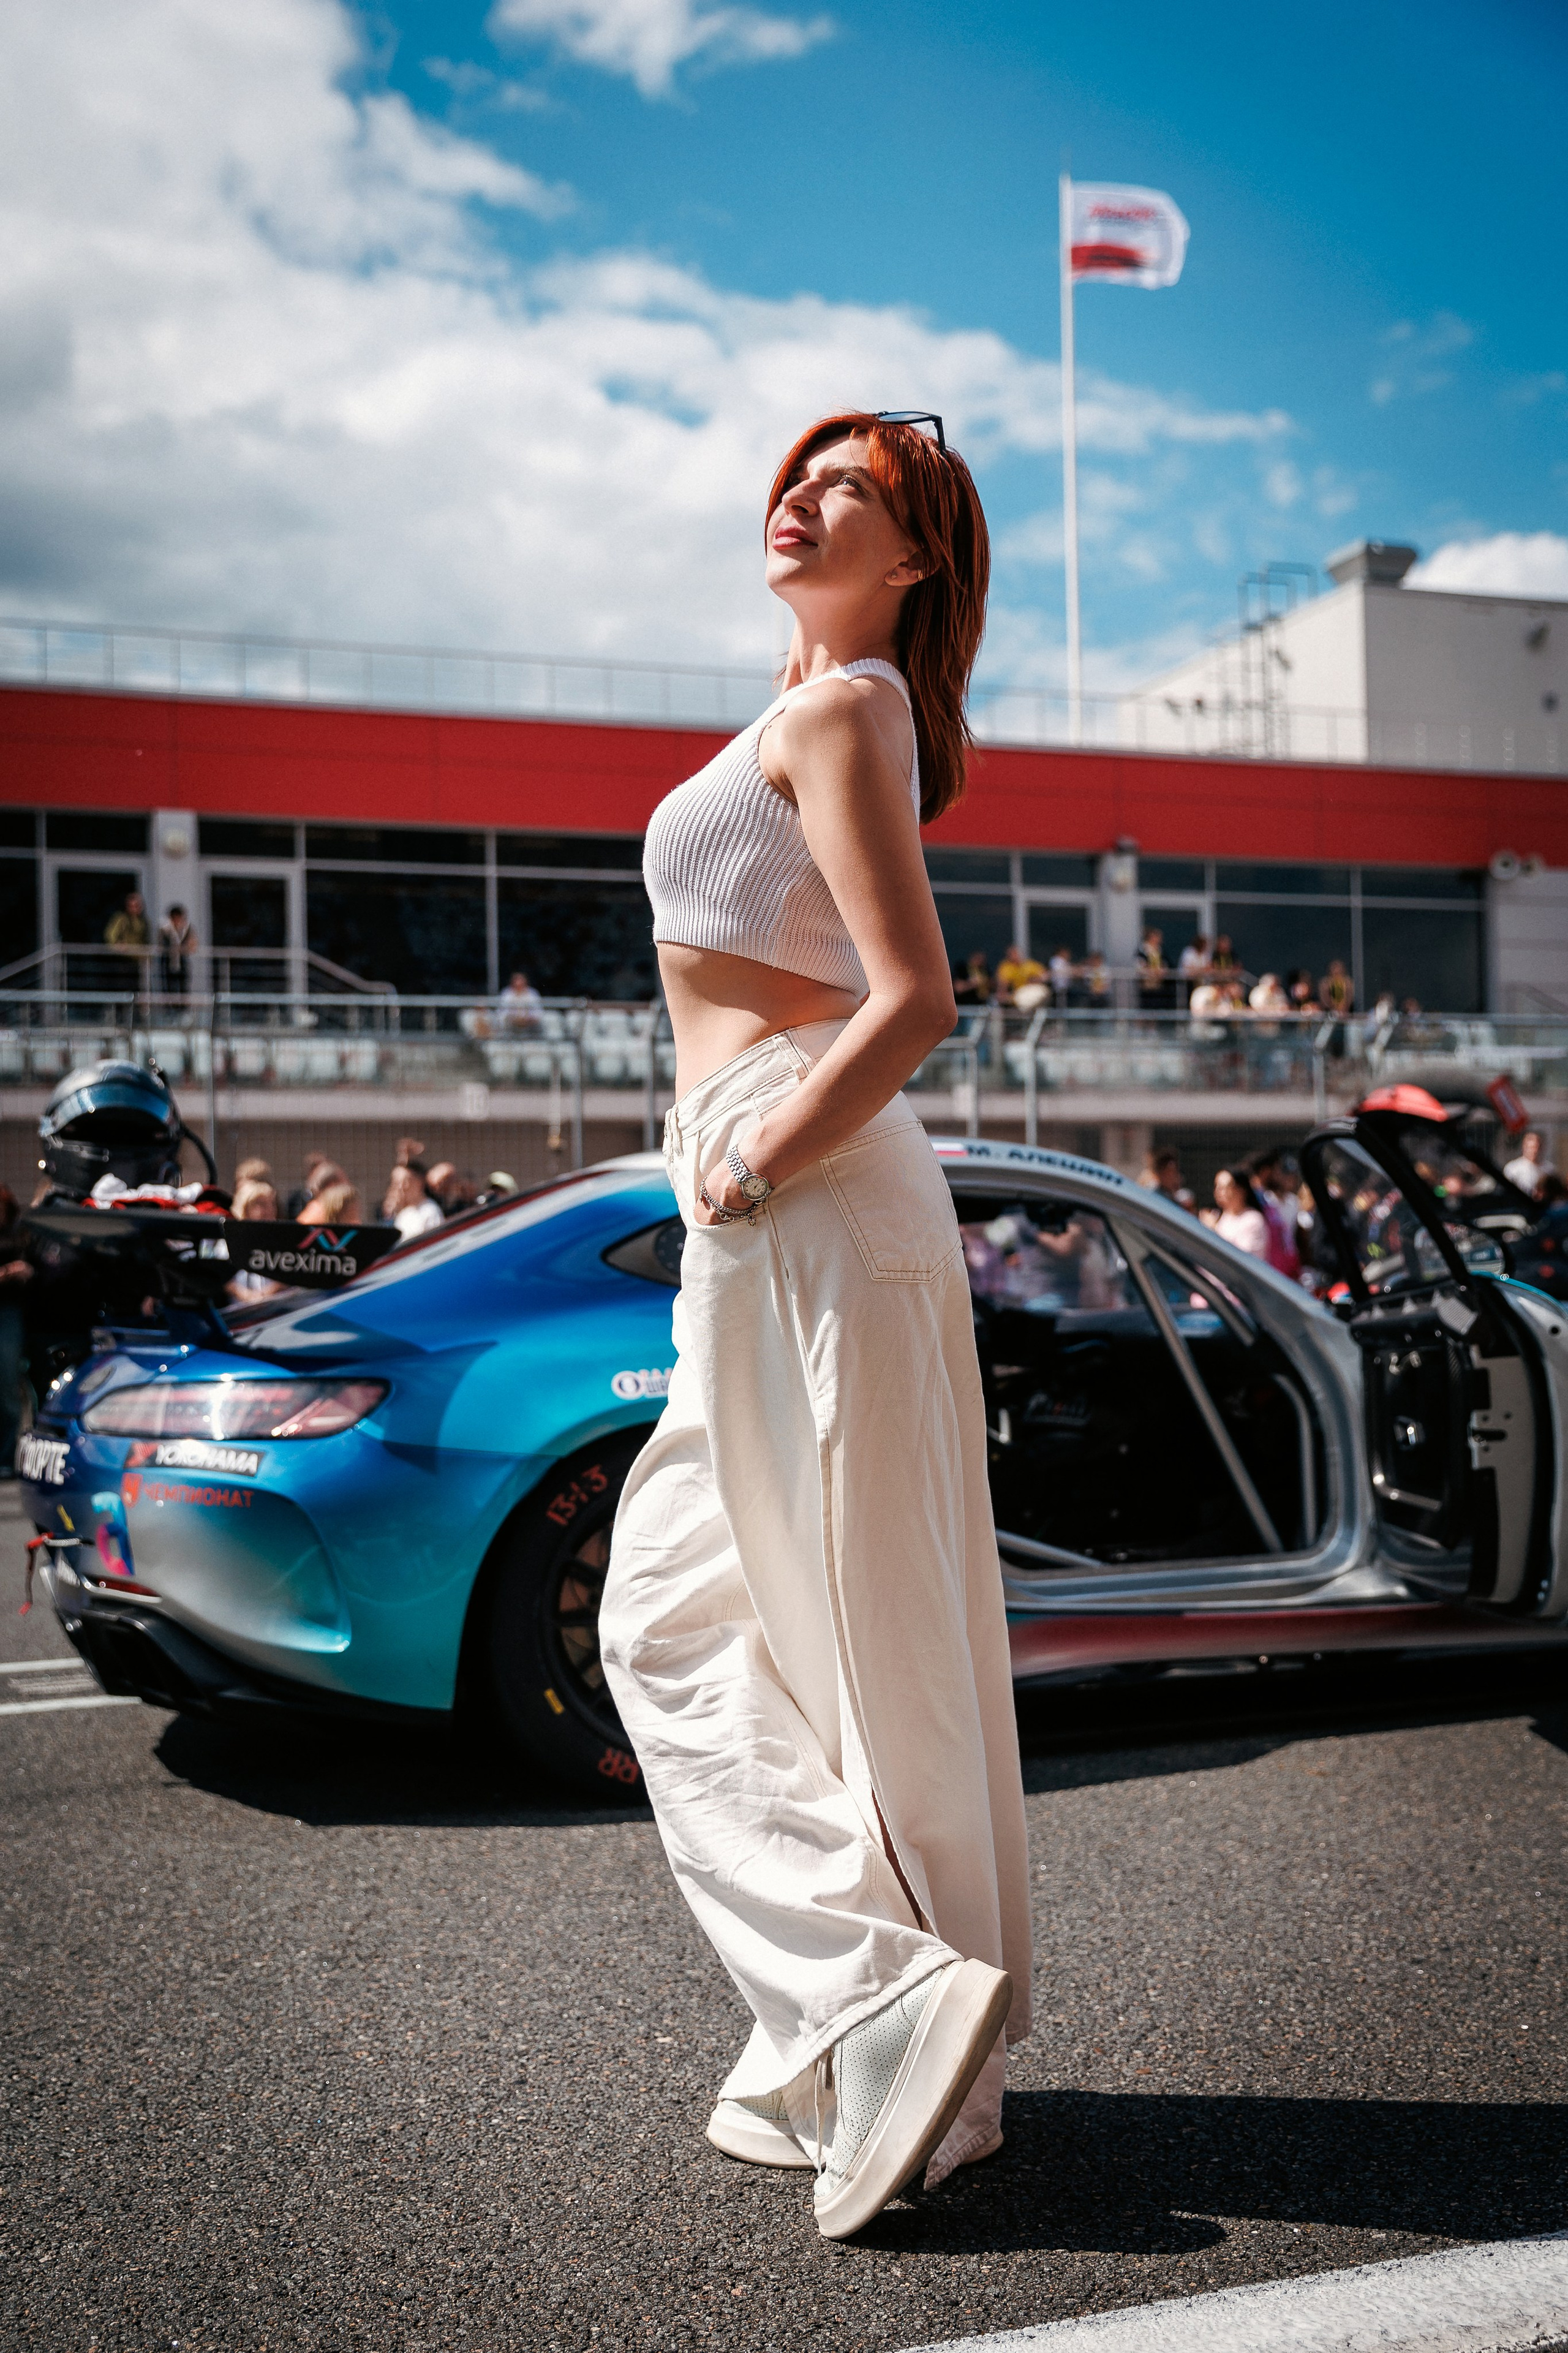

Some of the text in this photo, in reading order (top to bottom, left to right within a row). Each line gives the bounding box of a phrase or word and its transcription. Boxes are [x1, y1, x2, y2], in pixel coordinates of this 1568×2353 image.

[249, 1248, 357, 1276] avexima
[155, 1444, 258, 1475] YOKOHAMA
[144, 1482, 254, 1508] ЧЕМПИОНАТ
